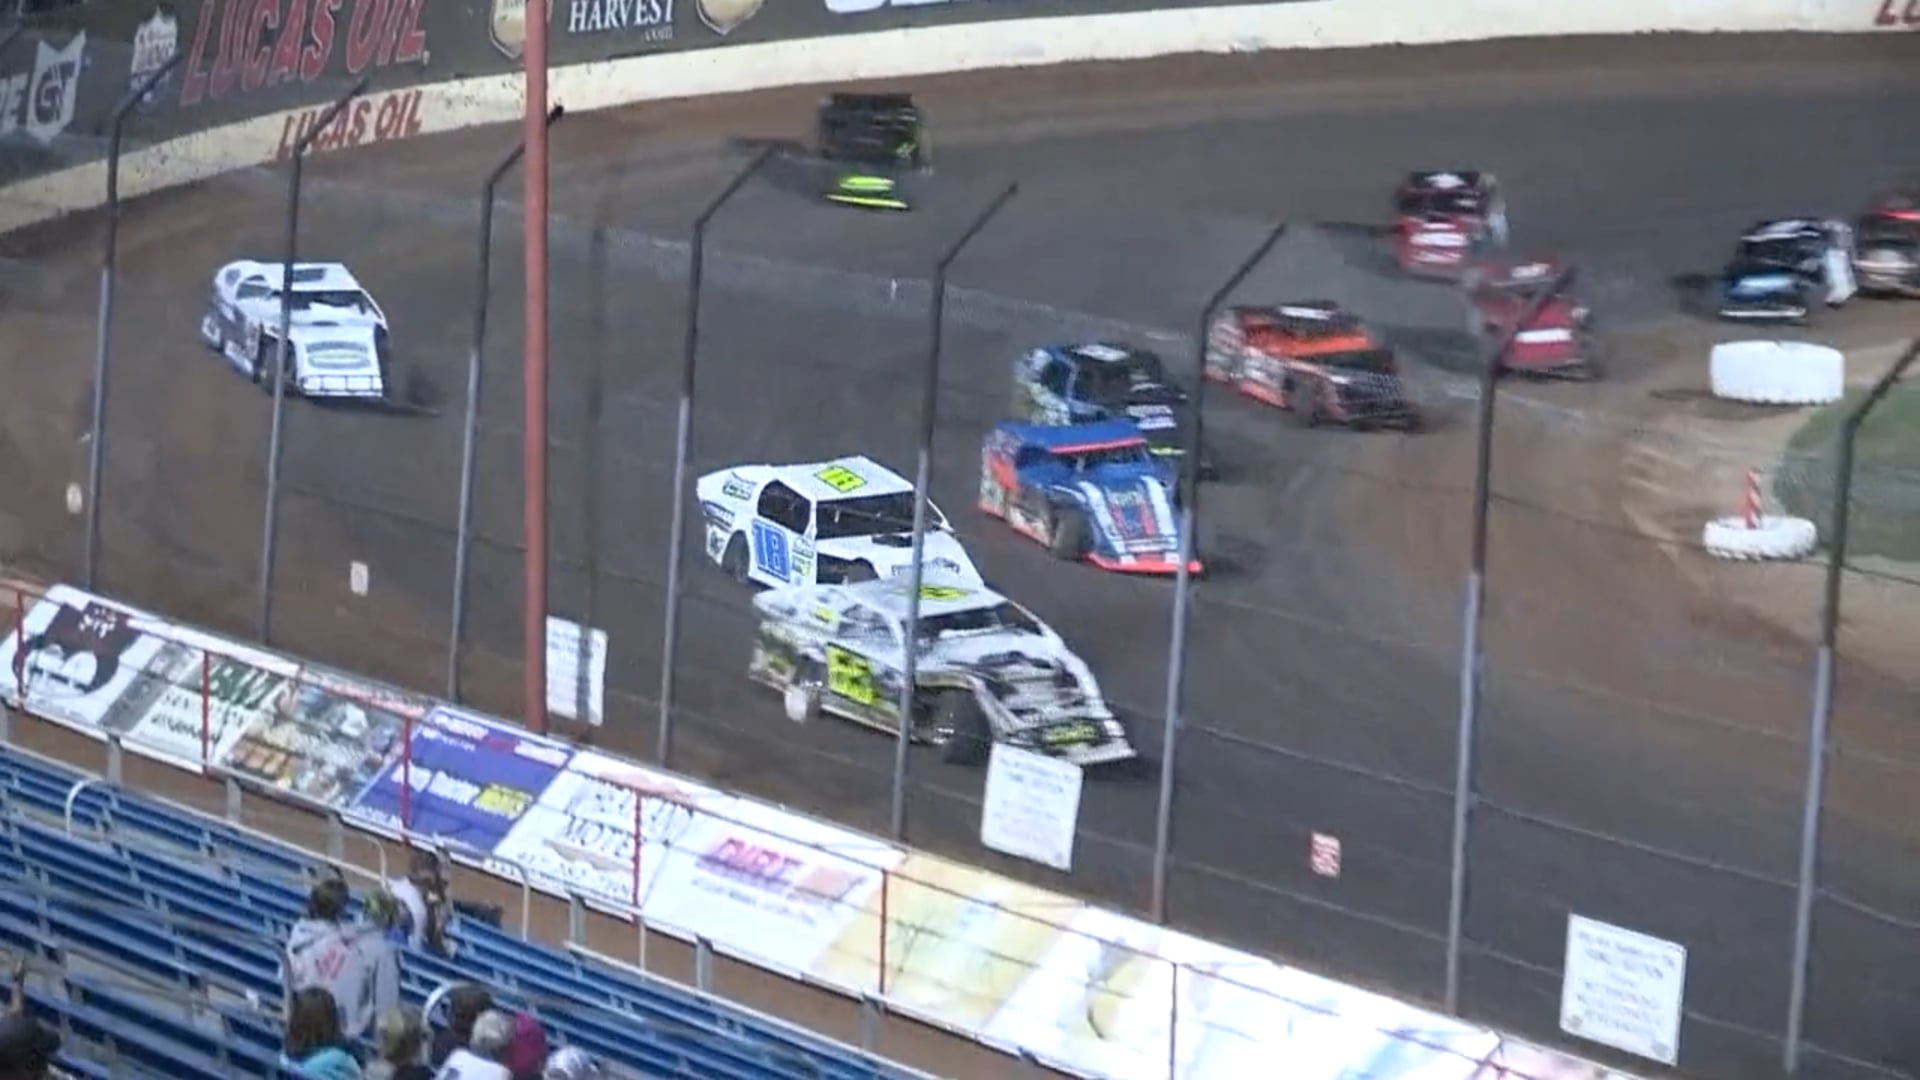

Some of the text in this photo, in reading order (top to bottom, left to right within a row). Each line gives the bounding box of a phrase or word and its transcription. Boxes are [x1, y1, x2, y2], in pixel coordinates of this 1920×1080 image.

[180, 0, 342, 105] LUCAS
[568, 0, 674, 33] HARVEST
[277, 89, 424, 161] LUCAS OIL
